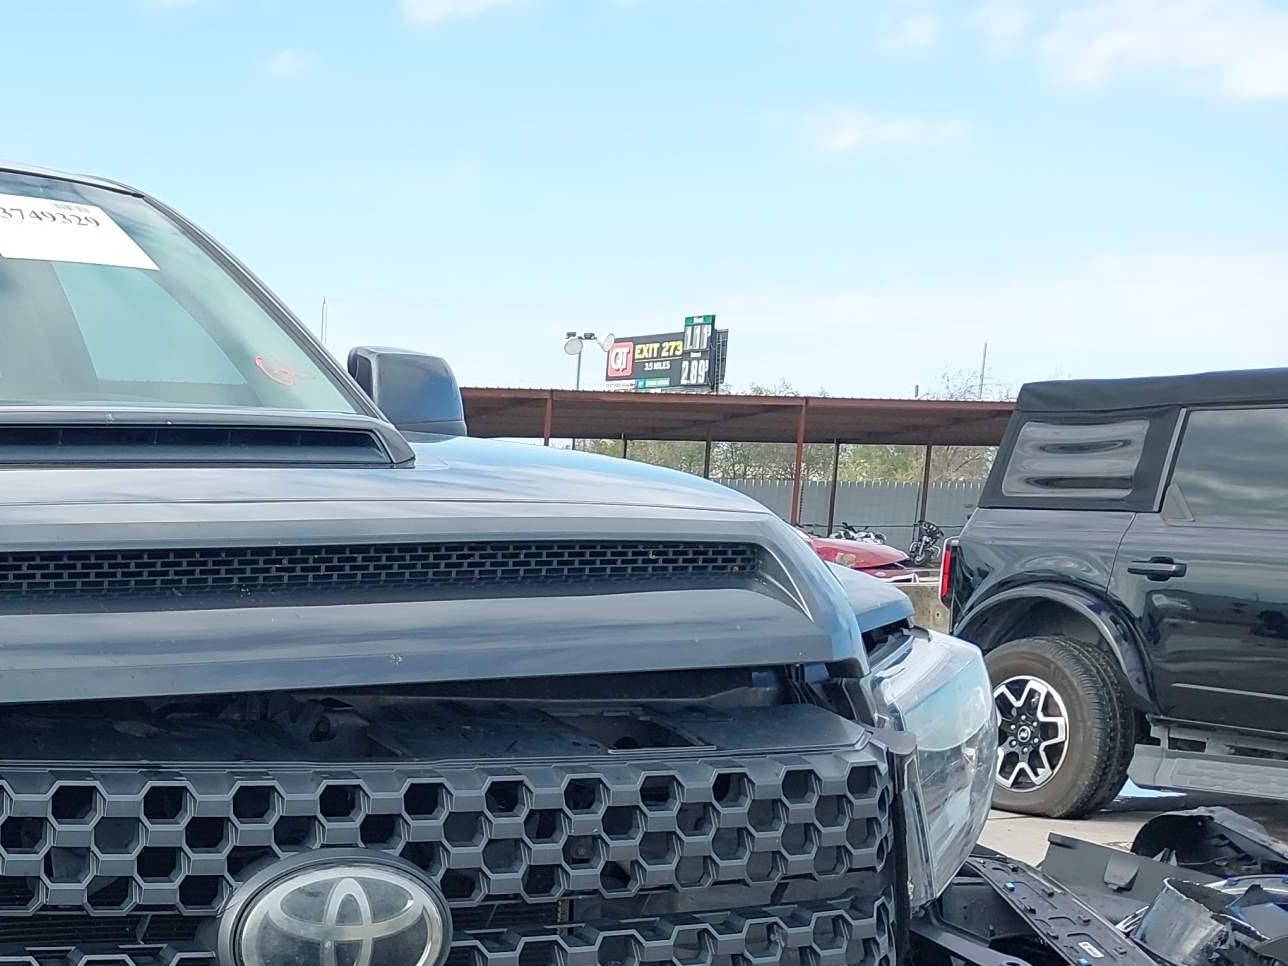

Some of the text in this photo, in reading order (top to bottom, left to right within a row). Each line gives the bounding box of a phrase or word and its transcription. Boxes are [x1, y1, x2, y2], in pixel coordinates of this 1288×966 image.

[612, 346, 631, 372] QT
[634, 340, 683, 359] EXIT 273
[653, 360, 670, 370] MILES
